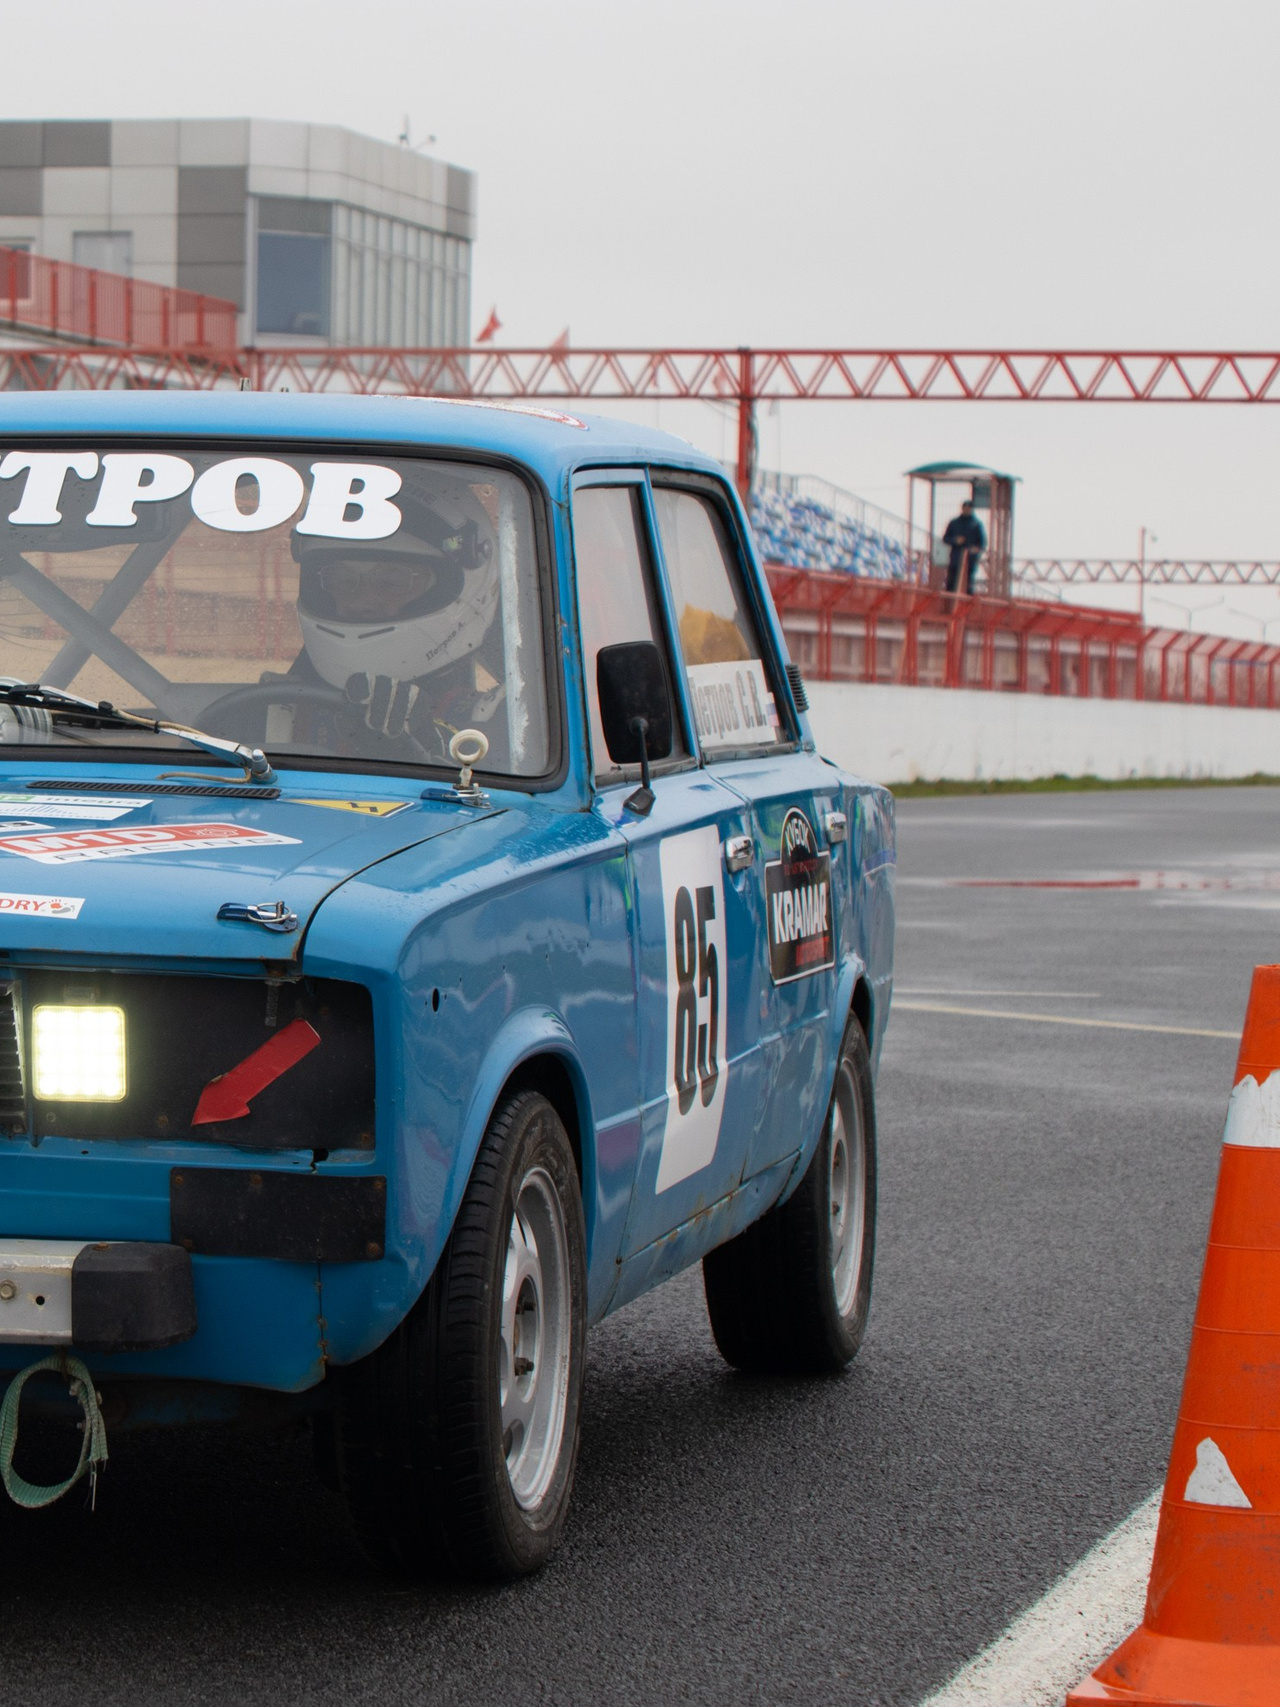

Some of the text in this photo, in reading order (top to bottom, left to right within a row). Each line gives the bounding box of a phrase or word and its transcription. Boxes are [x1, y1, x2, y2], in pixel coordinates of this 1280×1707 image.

[4, 830, 176, 852] M1D
[54, 837, 283, 861] RACING
[773, 882, 828, 944] KRAMAR
[674, 885, 719, 1116] 85
